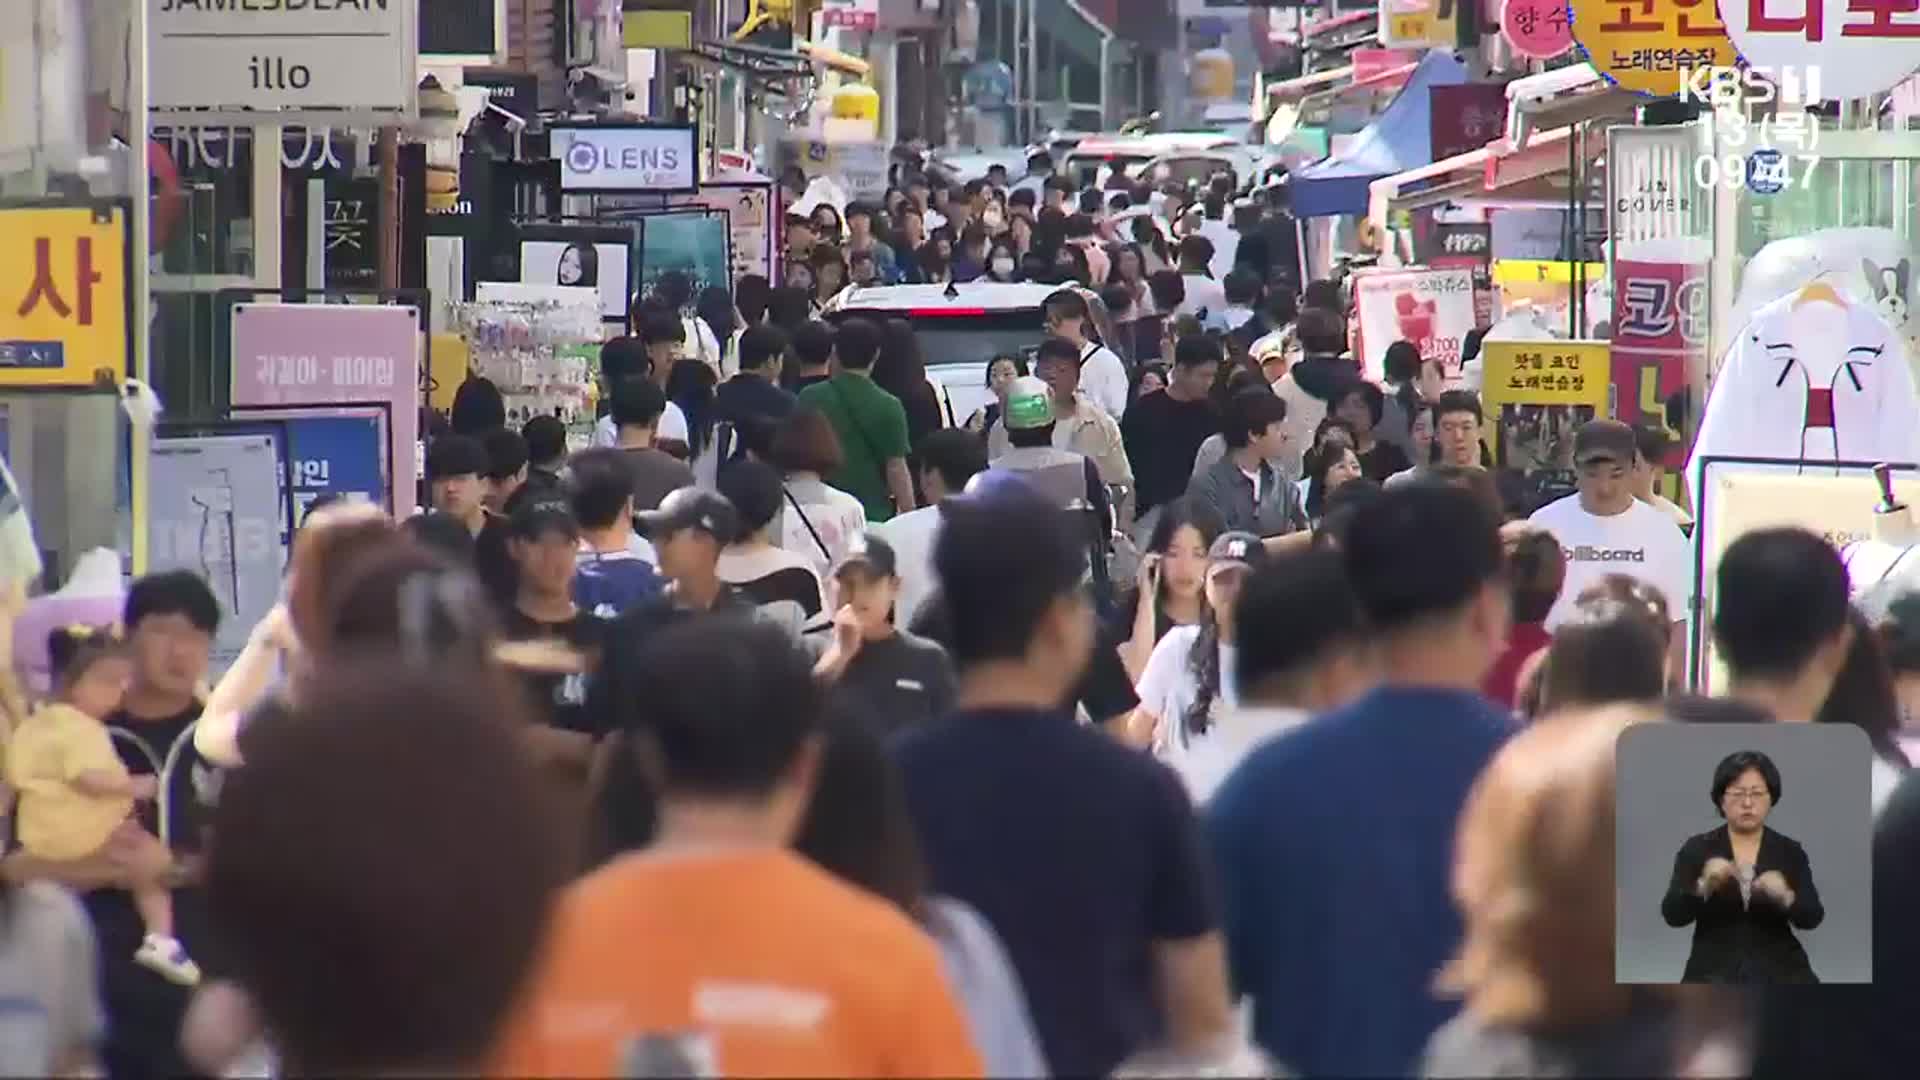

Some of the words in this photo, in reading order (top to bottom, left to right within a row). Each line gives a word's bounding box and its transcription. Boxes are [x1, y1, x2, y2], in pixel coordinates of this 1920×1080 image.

[1514, 5, 1567, 36] 향수
[248, 56, 311, 89] illo
[1609, 48, 1716, 71] 노래연습장
[17, 237, 101, 326] 사
[1549, 353, 1580, 370] 코인
[1507, 374, 1585, 392] 노래연습장
